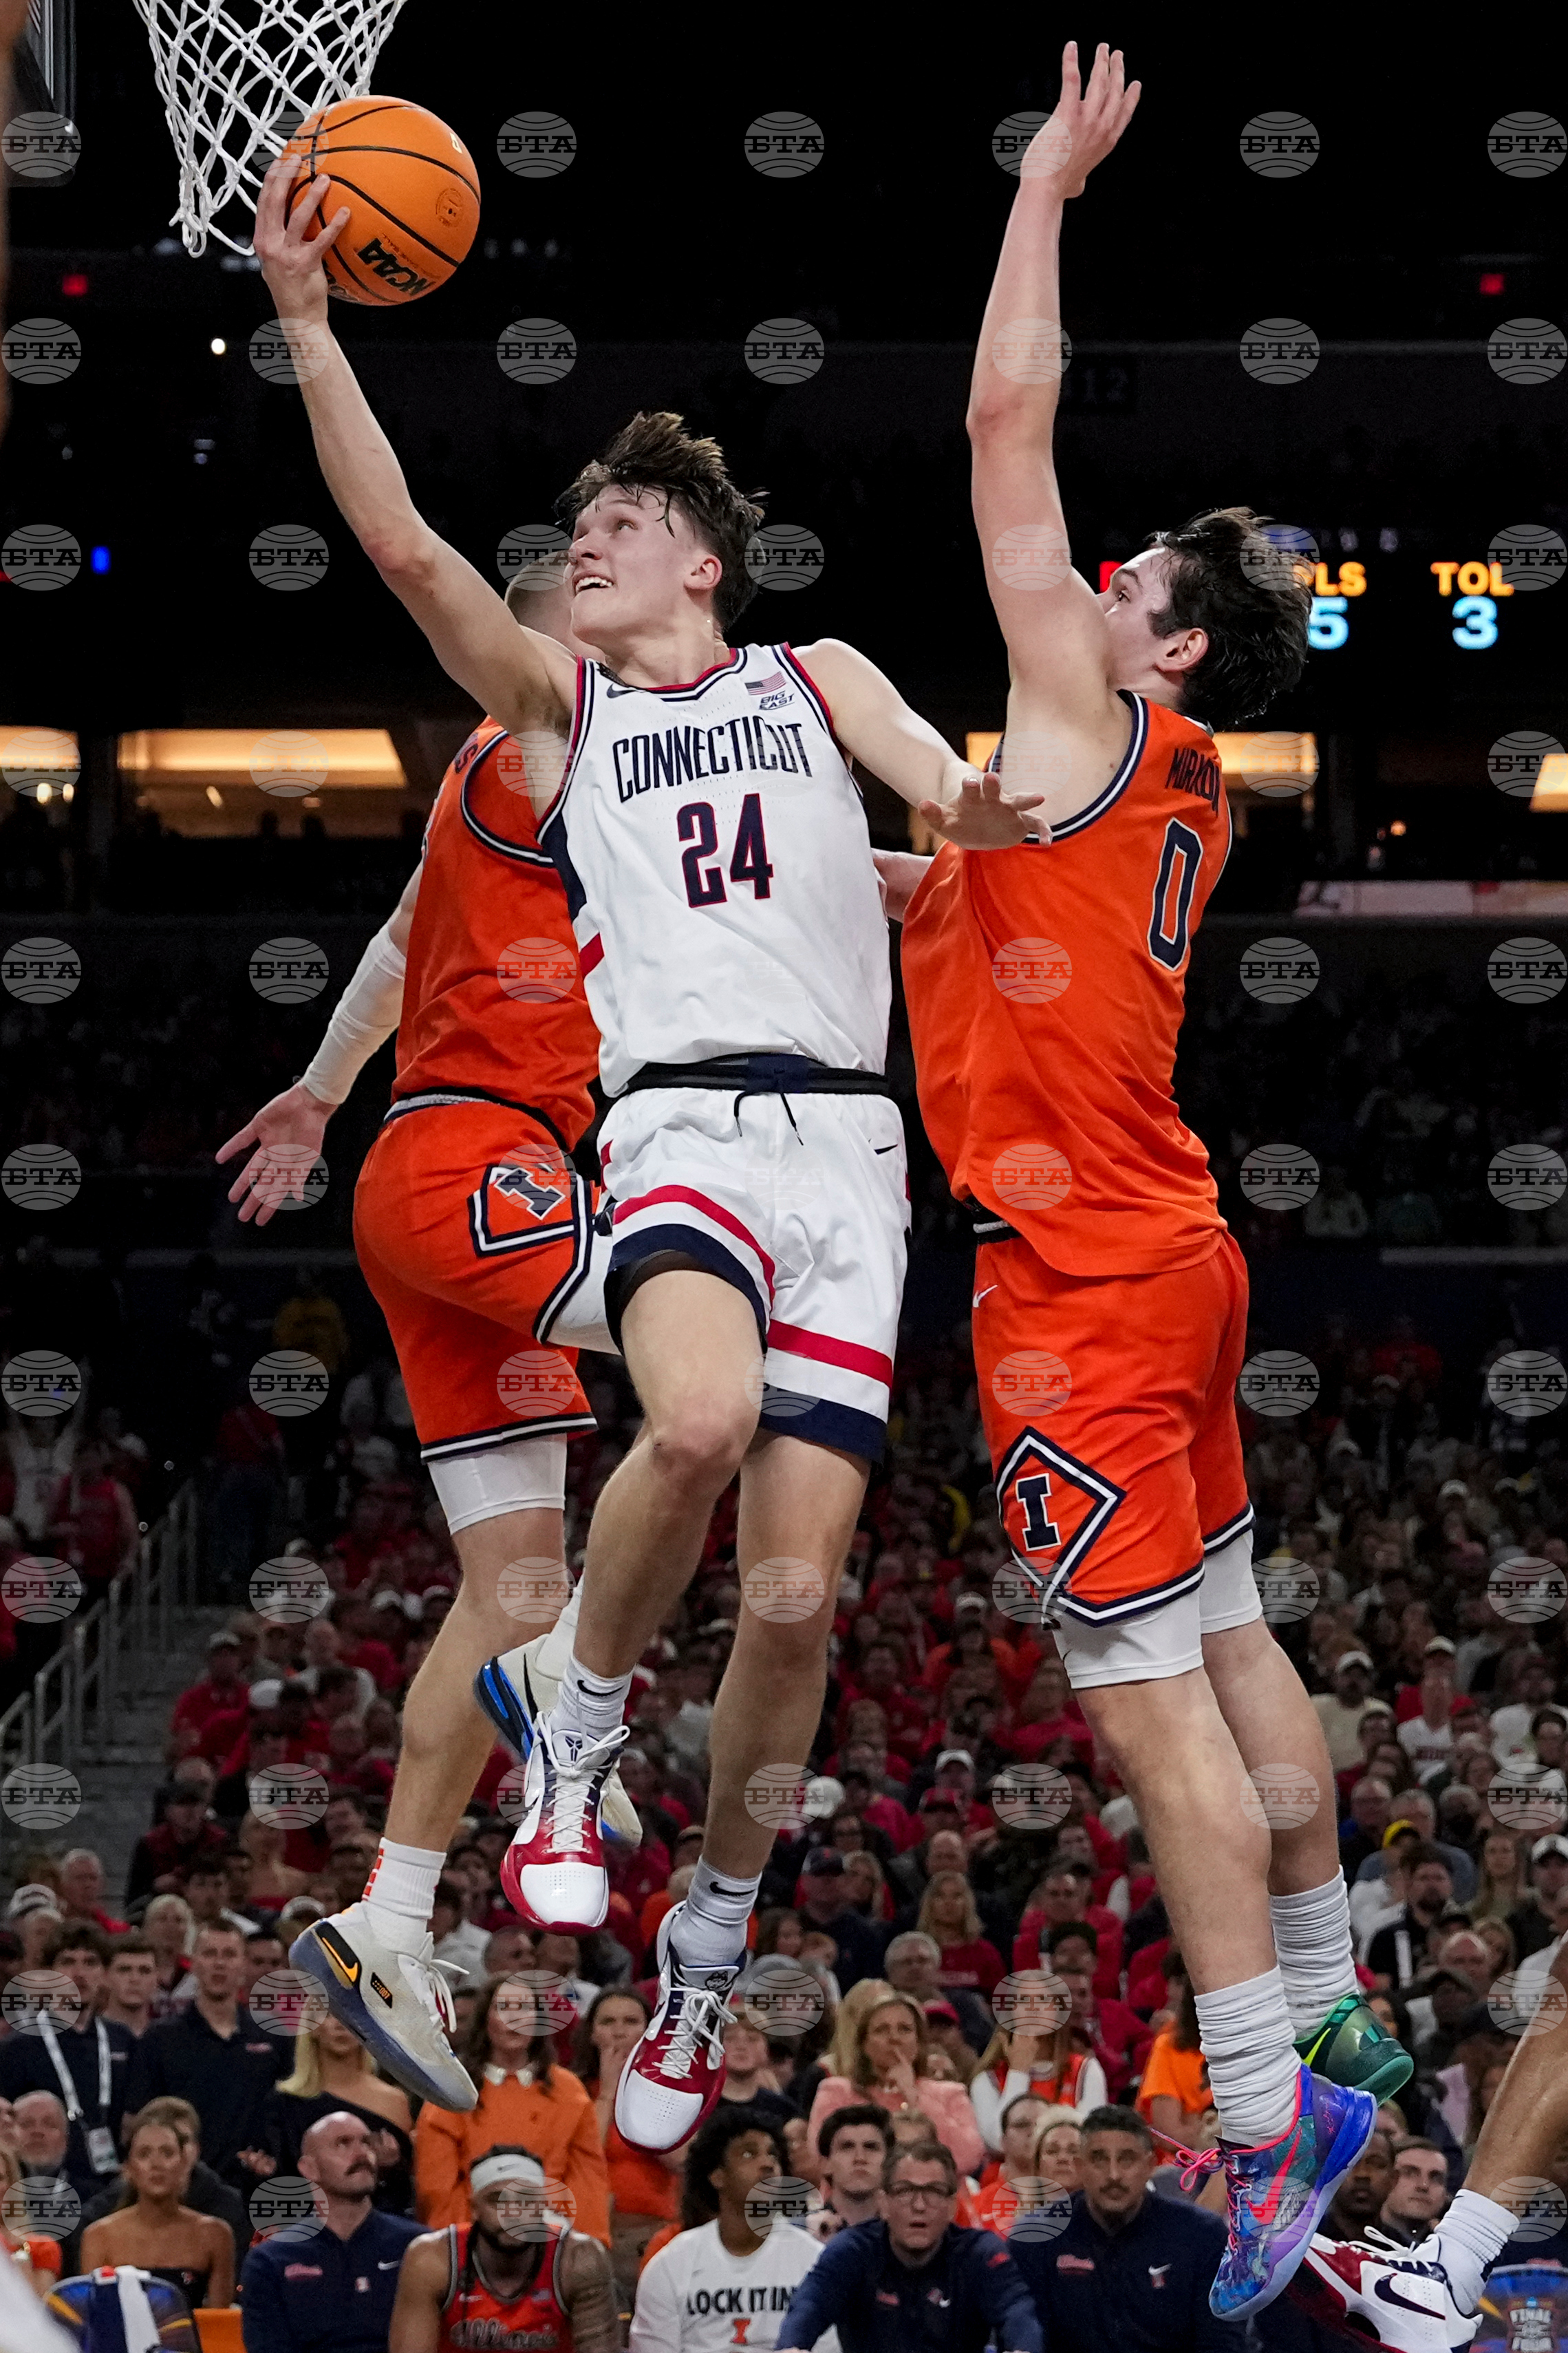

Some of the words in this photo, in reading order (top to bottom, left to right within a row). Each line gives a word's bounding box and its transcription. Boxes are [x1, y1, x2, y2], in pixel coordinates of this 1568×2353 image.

[357, 238, 436, 296] NCAA
[1430, 561, 1514, 597] TOL
[1452, 595, 1499, 650] 3
[760, 690, 786, 704] BIG
[760, 693, 795, 710] EAST
[612, 715, 813, 803] CONNECTICUT
[676, 793, 773, 908] 24
[1147, 817, 1203, 972] 0
[687, 2287, 744, 2316] LOCK
[749, 2287, 767, 2313] IT
